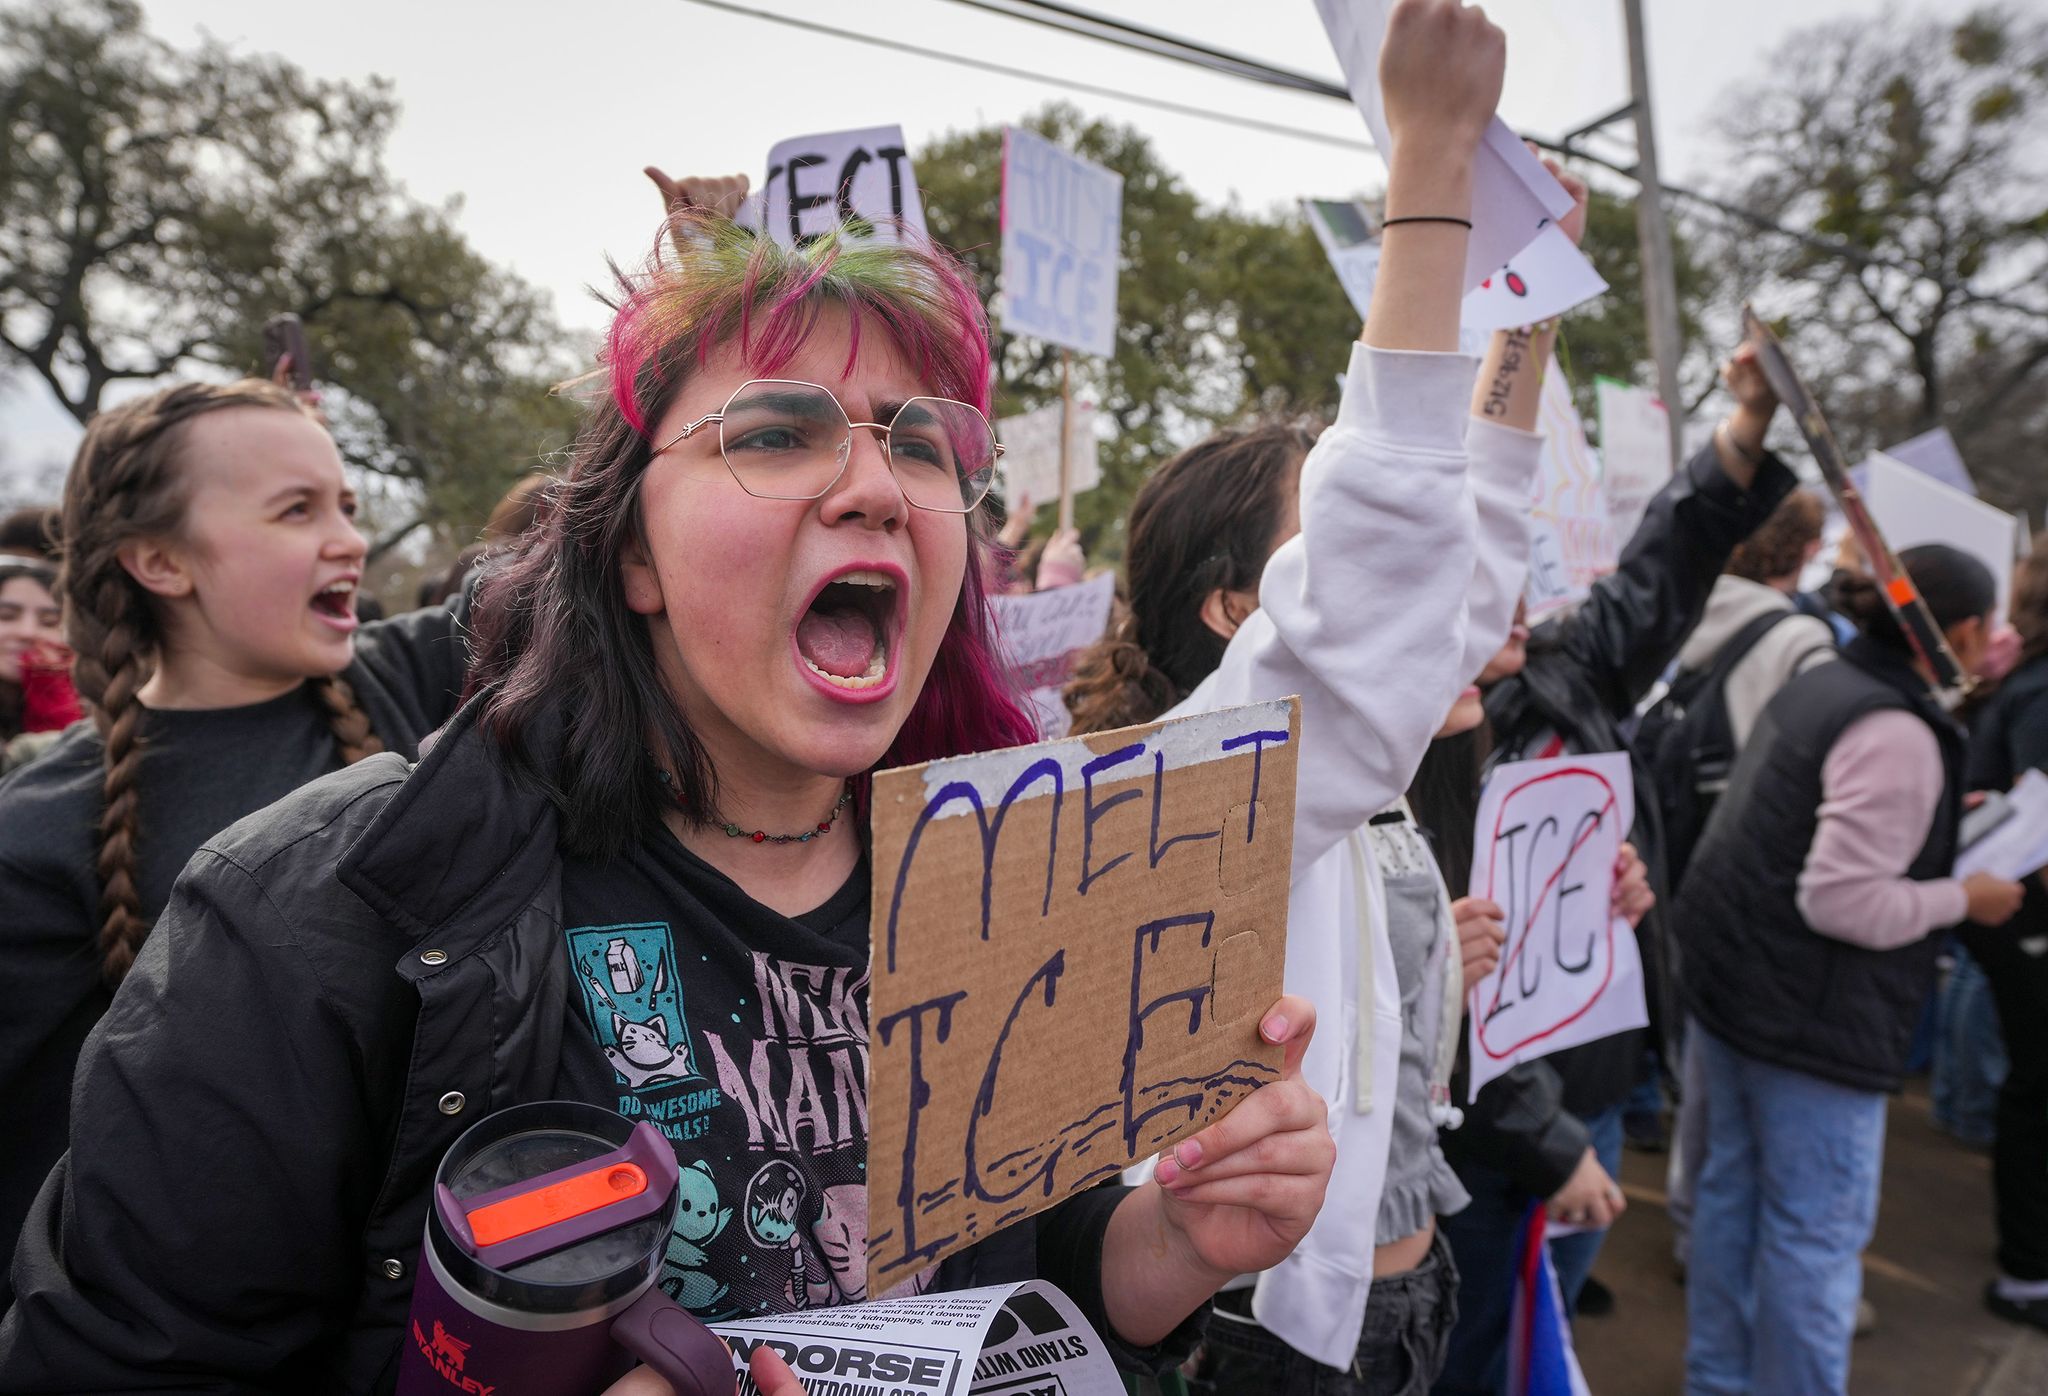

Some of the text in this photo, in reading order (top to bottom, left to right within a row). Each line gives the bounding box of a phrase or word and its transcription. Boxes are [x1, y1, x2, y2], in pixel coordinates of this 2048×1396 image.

[887, 730, 1289, 974] MELT
[1484, 811, 1602, 1026] ICE
[619, 1095, 641, 1117] DO
[876, 910, 1214, 1274] ICE
[821, 1319, 849, 1328] basic
[849, 1318, 885, 1331] rights!
[861, 1314, 925, 1326] kidnappings,
[930, 1319, 952, 1327] and
[955, 1321, 977, 1329] end
[935, 1310, 964, 1319] down
[718, 1335, 946, 1388] NDORSE
[1016, 1335, 1089, 1369] STAND
